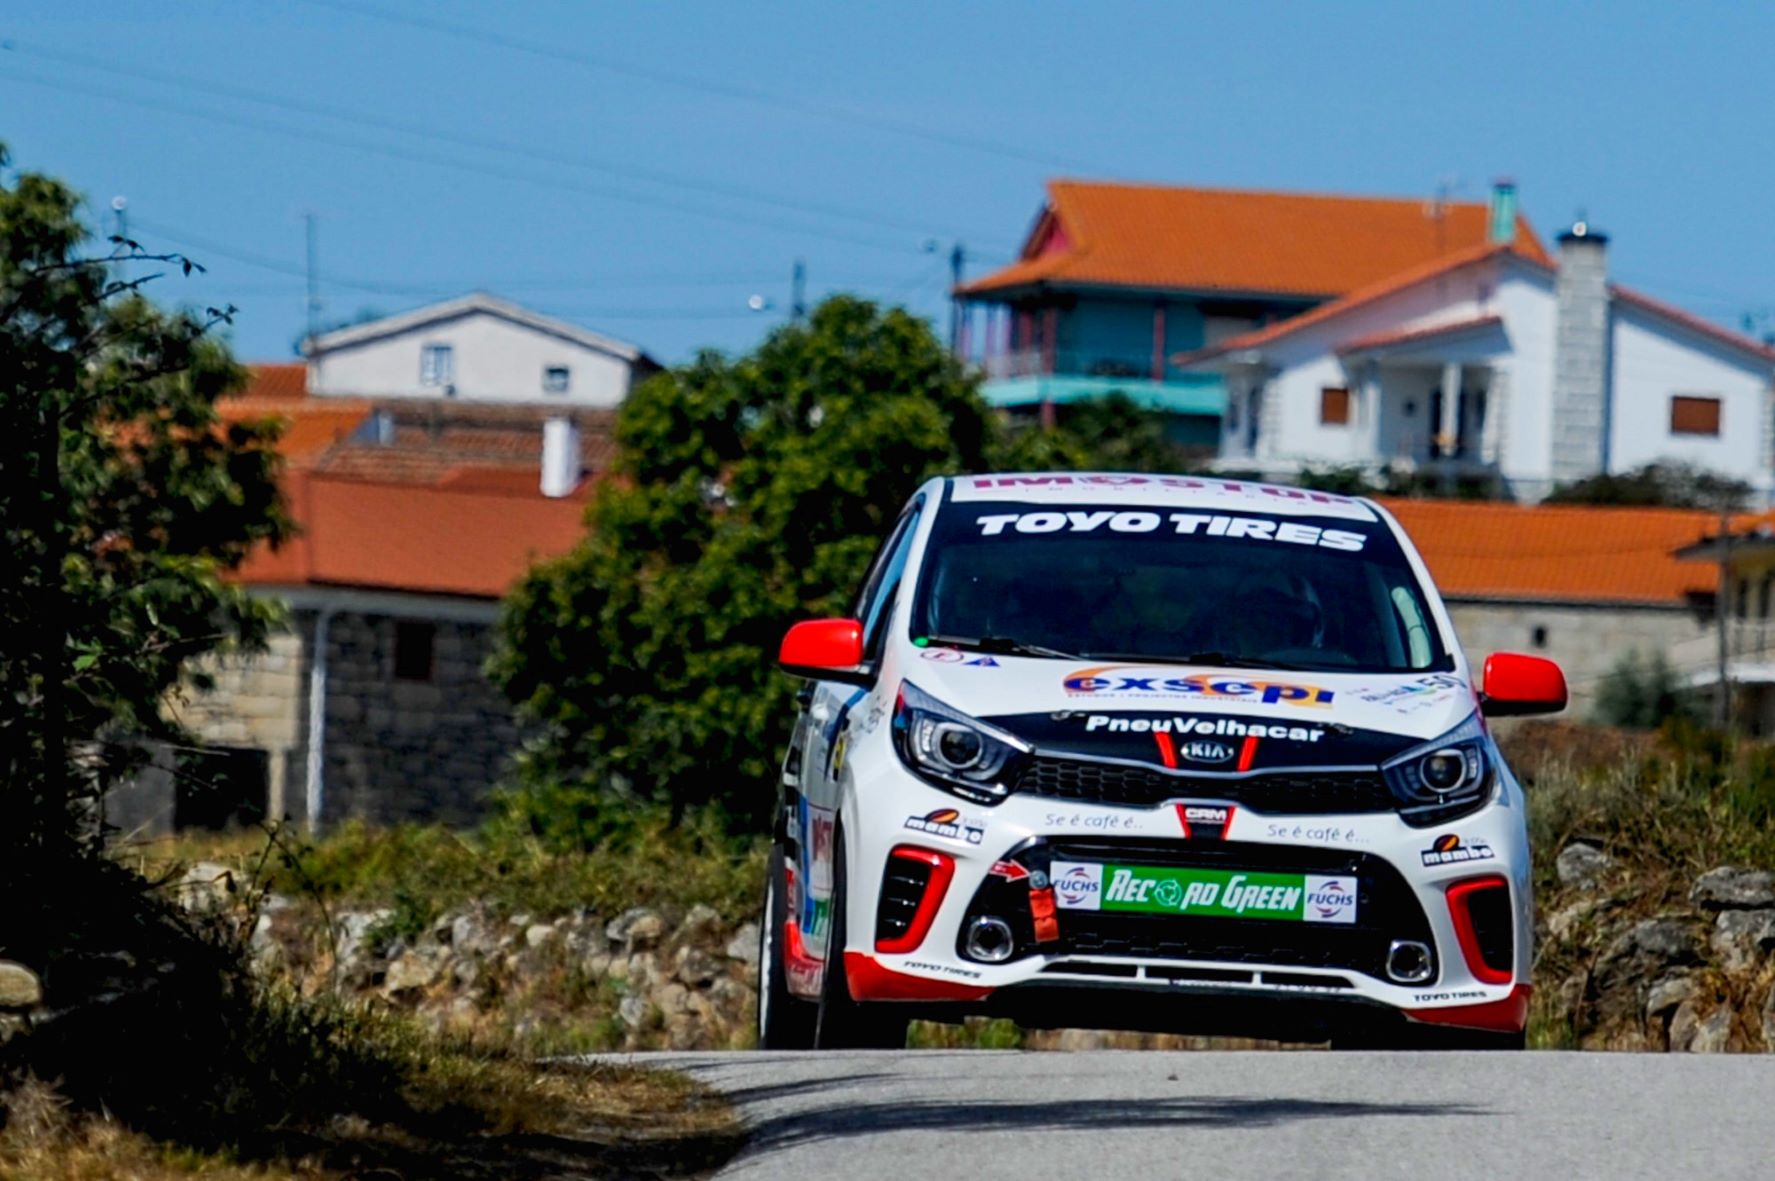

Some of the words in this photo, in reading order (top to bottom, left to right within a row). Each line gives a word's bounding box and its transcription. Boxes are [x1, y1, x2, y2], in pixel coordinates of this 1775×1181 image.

[975, 511, 1161, 535] TOYO
[1169, 513, 1367, 551] TIRES
[1086, 715, 1325, 742] PneuVelhacar
[1191, 741, 1225, 758] KIA
[1045, 813, 1066, 827] Se
[1084, 815, 1120, 830] café
[1267, 824, 1288, 838] Se
[1306, 828, 1341, 842] café
[1053, 879, 1100, 893] FUCHS
[1307, 893, 1354, 906] FUCHS
[1414, 992, 1450, 1002] TOYO
[1451, 991, 1488, 999] TIRES
